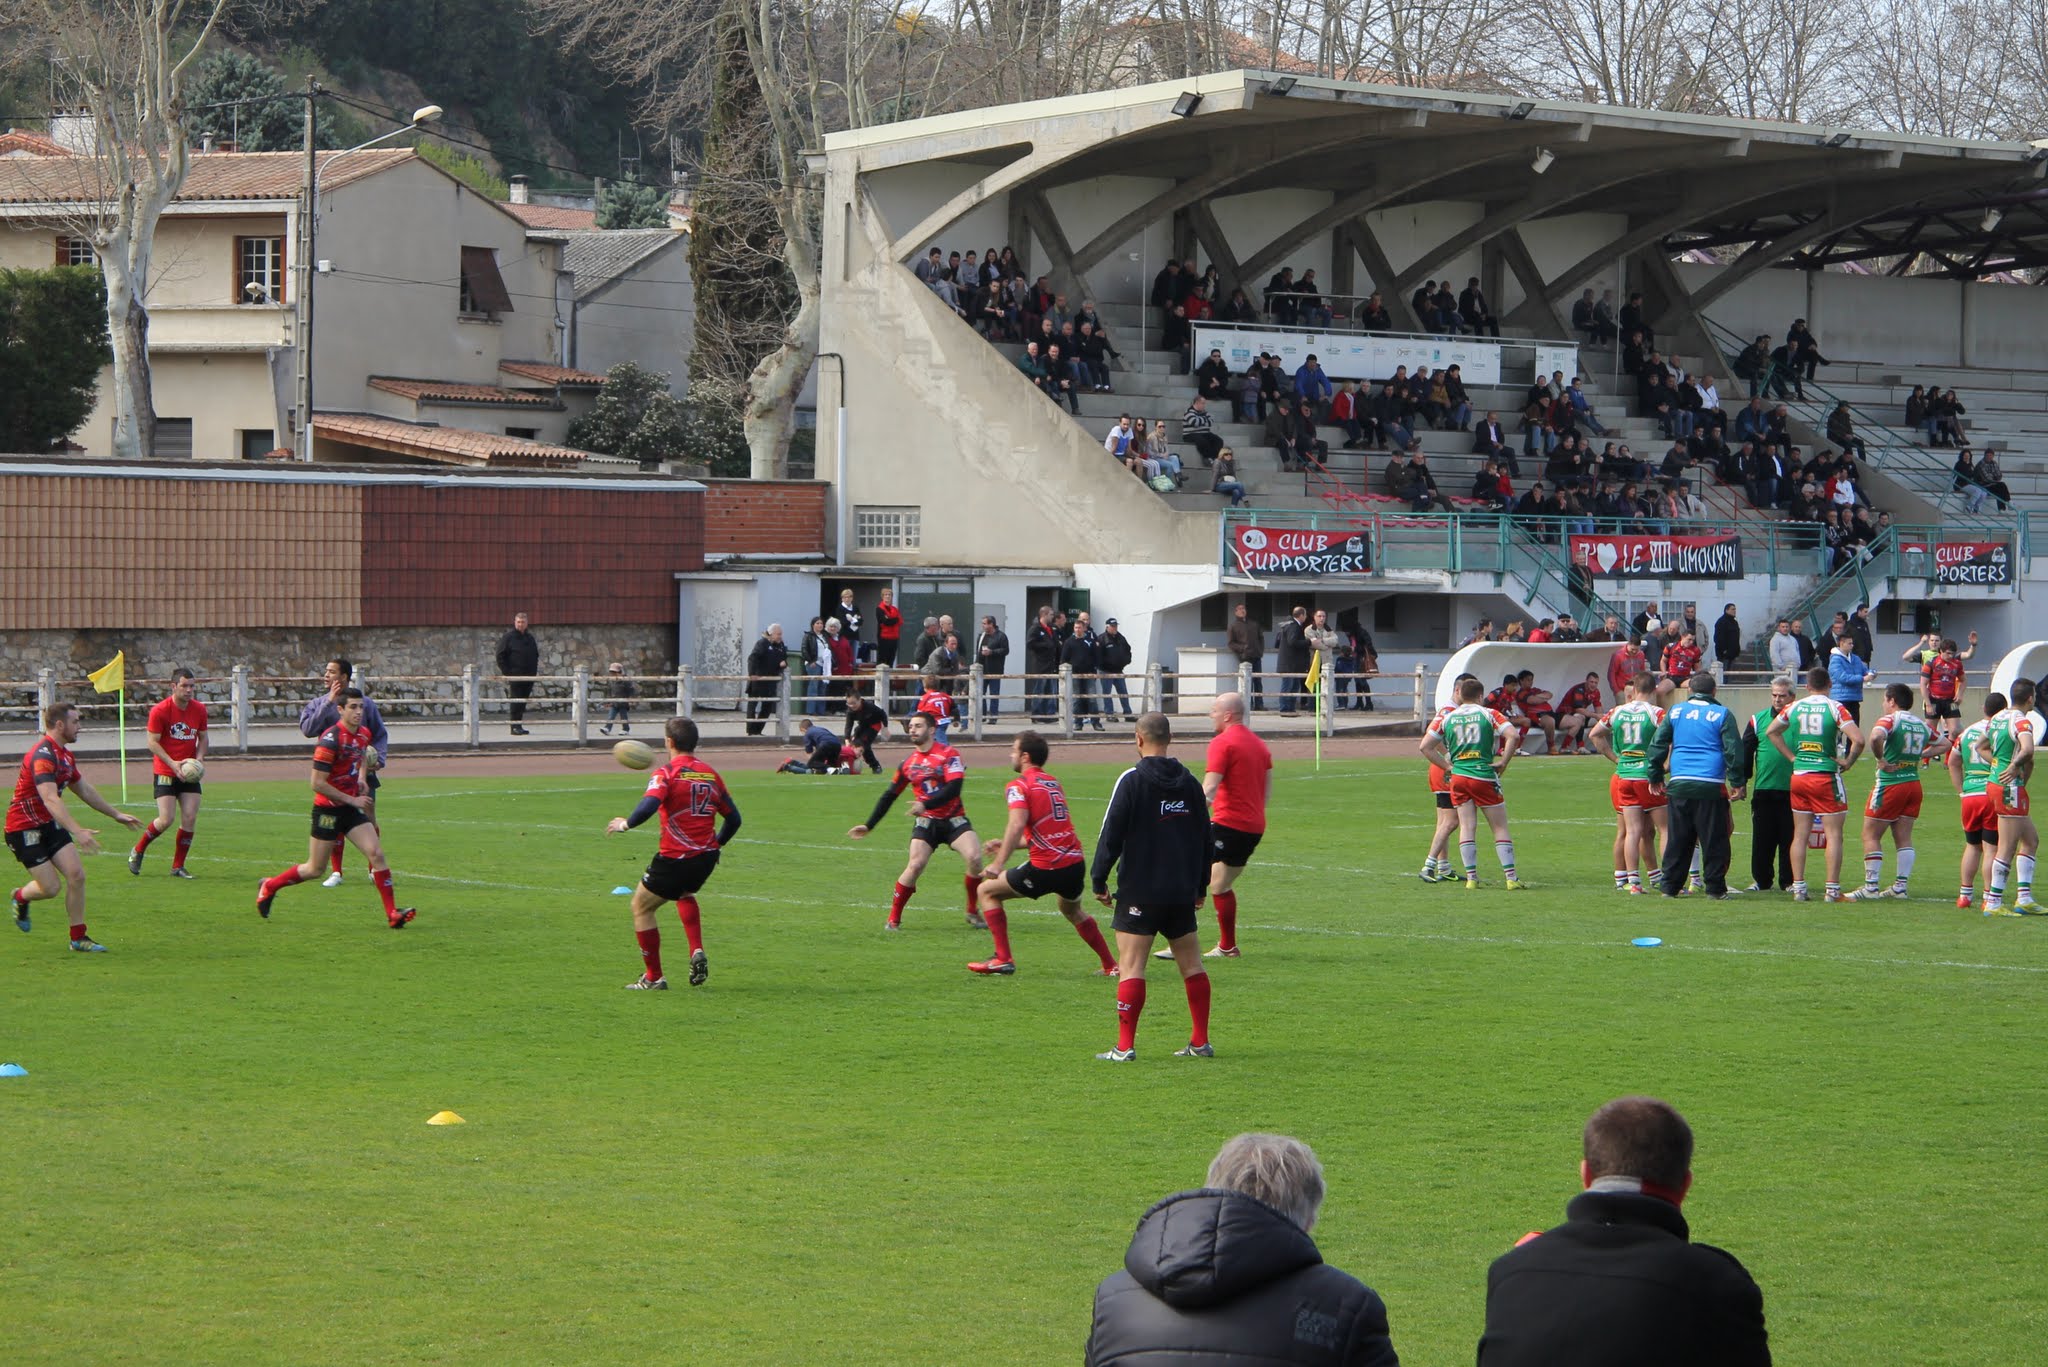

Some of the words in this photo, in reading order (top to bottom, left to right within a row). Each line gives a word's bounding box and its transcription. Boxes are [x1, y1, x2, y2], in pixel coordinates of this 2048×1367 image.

[1278, 534, 1328, 551] CLUB
[1244, 551, 1363, 572] SUPPORTERS
[1623, 544, 1643, 573] LE
[1649, 541, 1673, 572] XIII
[1678, 544, 1737, 573] LIMOUXIN
[1936, 546, 1974, 562] CLUB
[934, 701, 947, 717] 7
[1632, 713, 1645, 721] XIII
[1454, 723, 1481, 746] 10
[1621, 722, 1643, 744] 11
[1797, 713, 1823, 735] 19
[1902, 732, 1925, 755] 13
[690, 782, 712, 816] 12
[1049, 791, 1069, 821] 6
